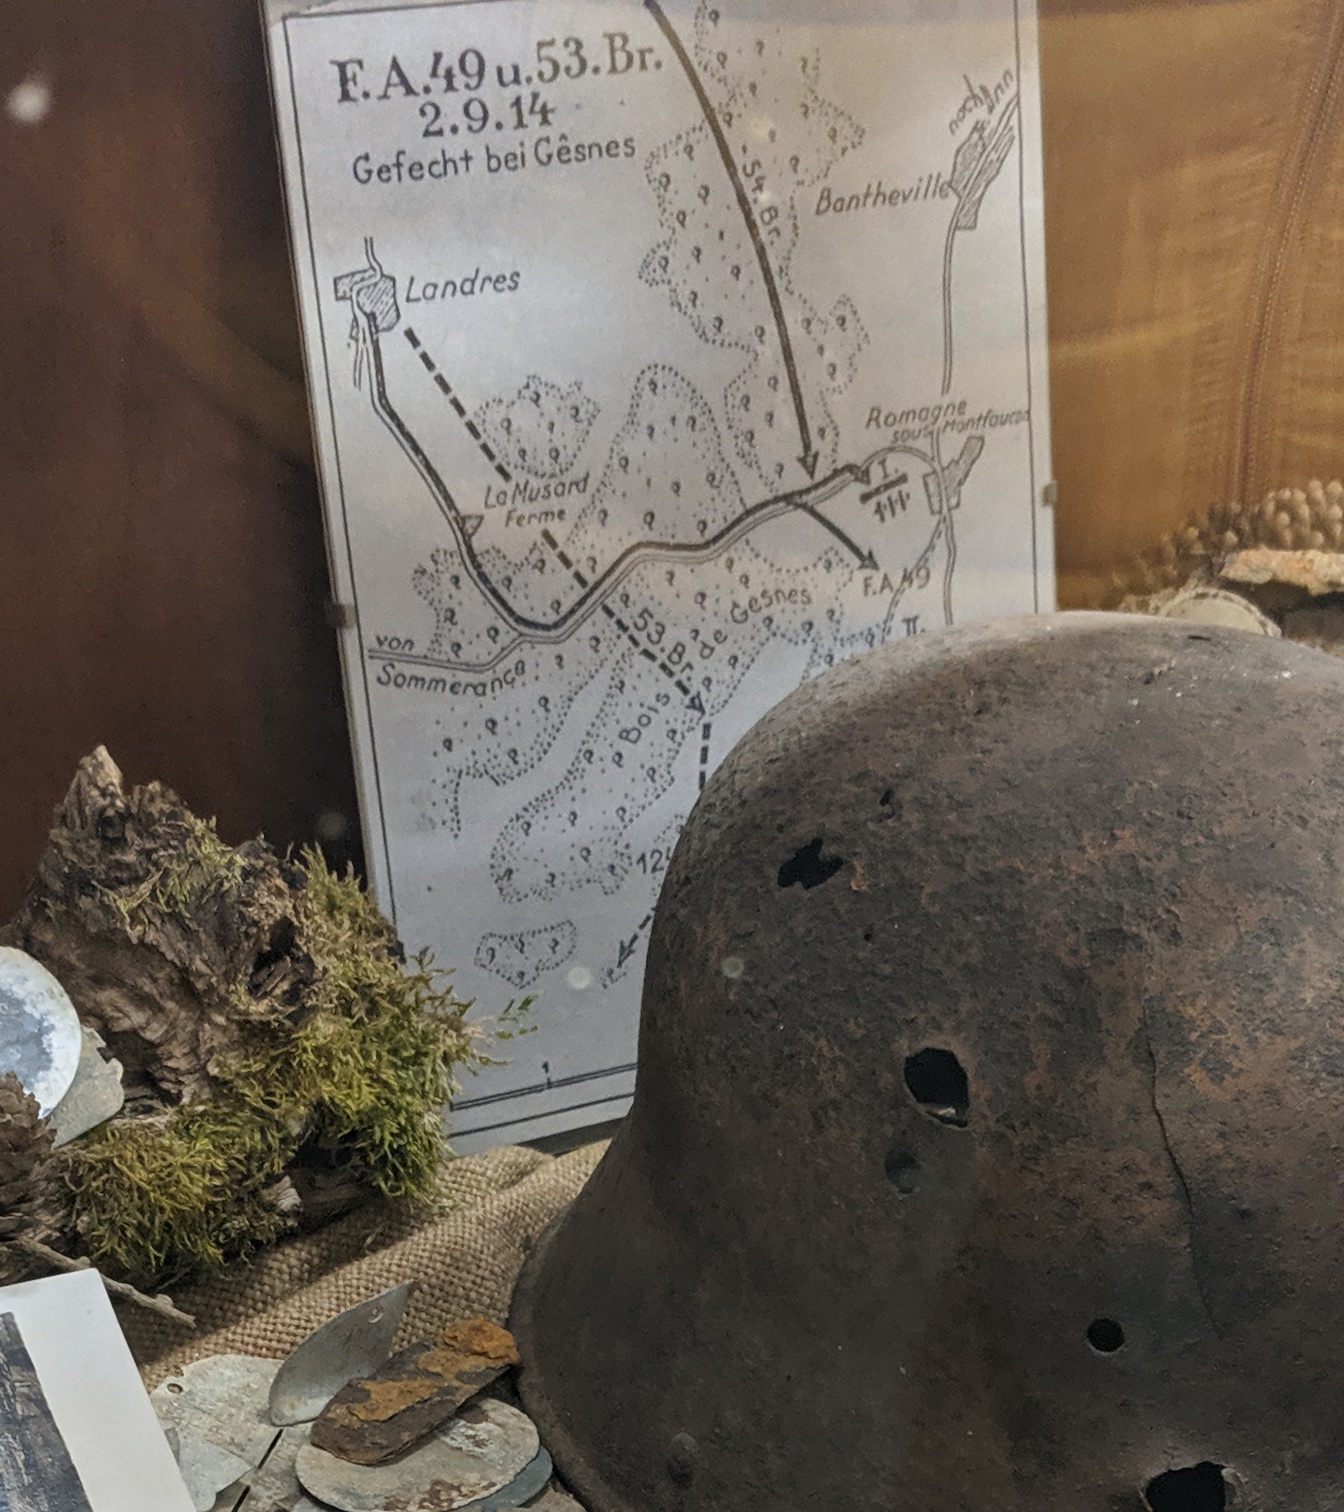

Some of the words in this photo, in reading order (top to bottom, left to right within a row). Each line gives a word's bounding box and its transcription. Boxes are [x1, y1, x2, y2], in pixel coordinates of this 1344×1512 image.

[418, 92, 556, 138] 2.9.14
[352, 148, 474, 184] Gefecht
[484, 141, 527, 173] bei
[533, 132, 637, 167] Gêsnes
[815, 170, 952, 217] Bantheville
[404, 266, 521, 305] Landres
[865, 399, 968, 431] Romagne
[511, 471, 590, 505] Musard
[505, 507, 566, 528] Ferme
[375, 634, 415, 652] von
[618, 692, 671, 745] Bois
[699, 629, 728, 660] de
